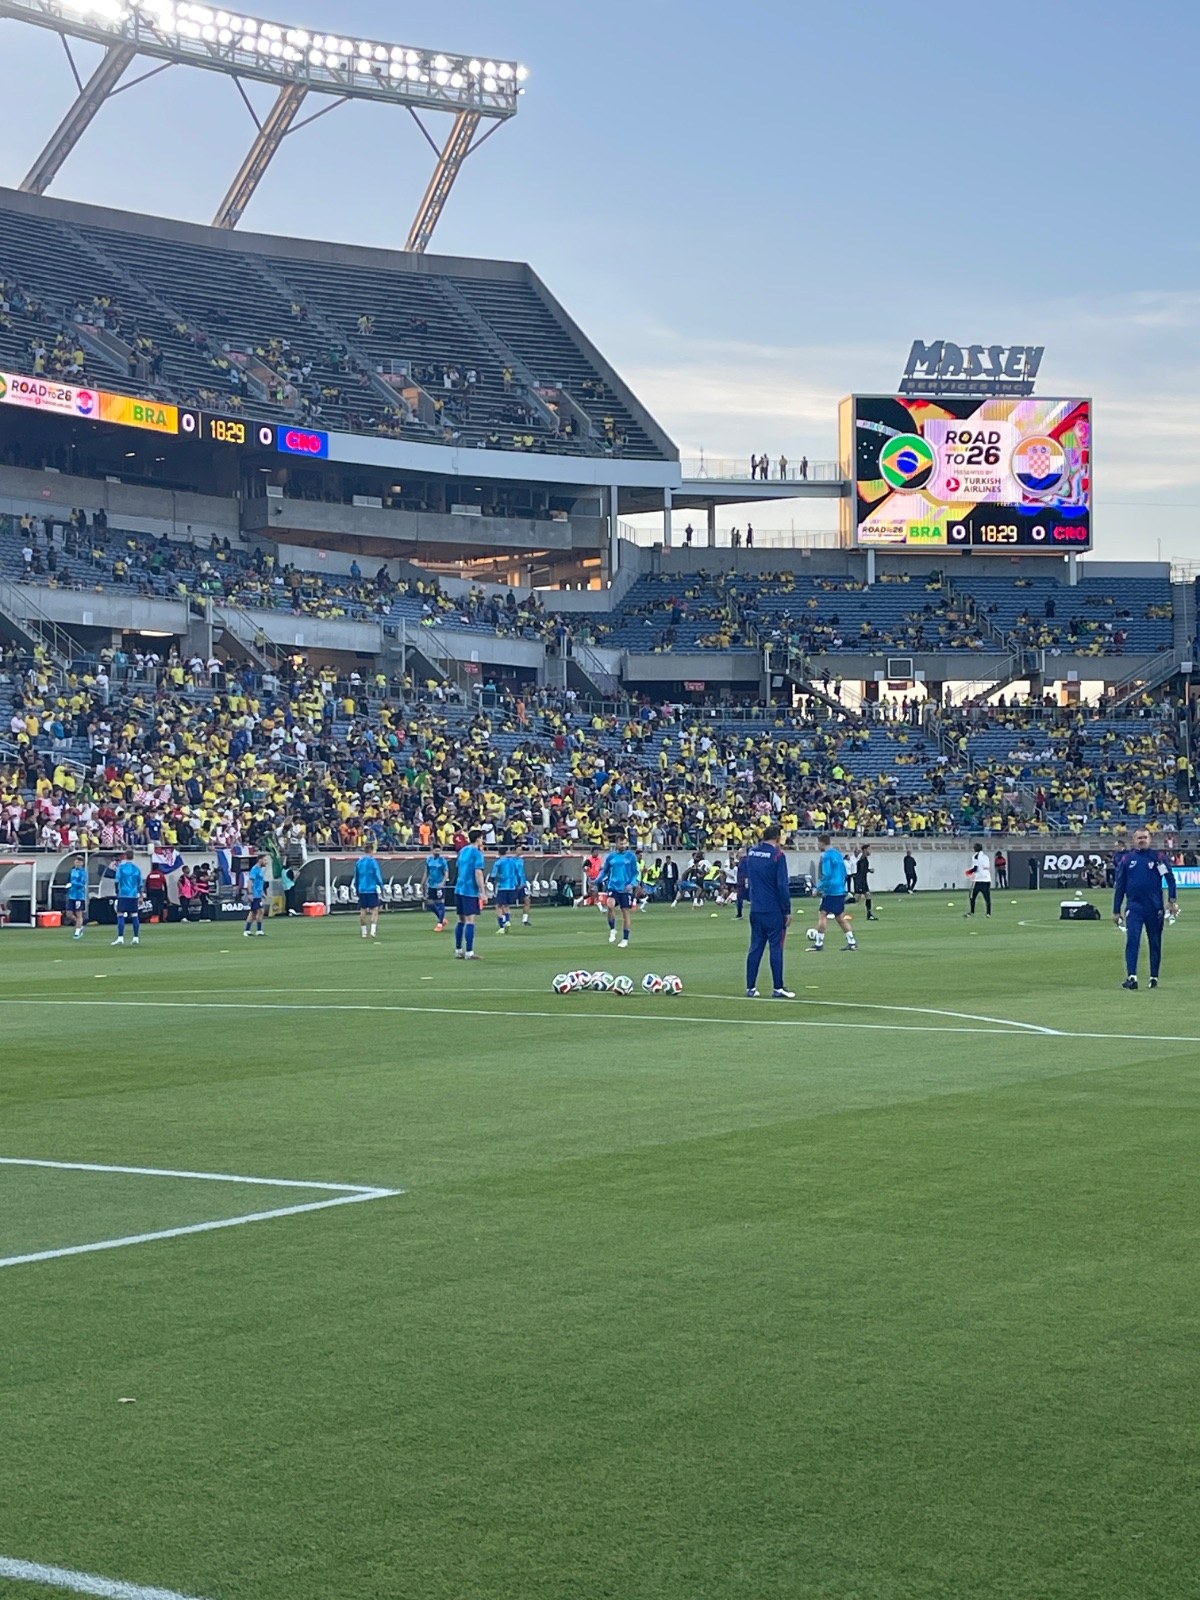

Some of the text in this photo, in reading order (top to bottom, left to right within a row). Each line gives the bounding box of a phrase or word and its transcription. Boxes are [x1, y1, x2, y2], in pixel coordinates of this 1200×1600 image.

[904, 340, 1045, 377] MASSEY
[11, 379, 47, 397] ROAD
[47, 391, 57, 399] TO
[906, 381, 1027, 391] SERVICES INC.
[133, 405, 167, 426] BRA
[182, 413, 195, 432] 0
[210, 419, 245, 444] 18:29
[259, 427, 273, 445] 0
[945, 430, 1001, 445] ROAD
[945, 454, 965, 465] TO
[964, 477, 1001, 485] TURKISH
[964, 485, 1001, 493] AIRLINES
[910, 525, 1087, 542] BRA 0 18:29 0 CRO
[221, 903, 244, 912] ROAD
